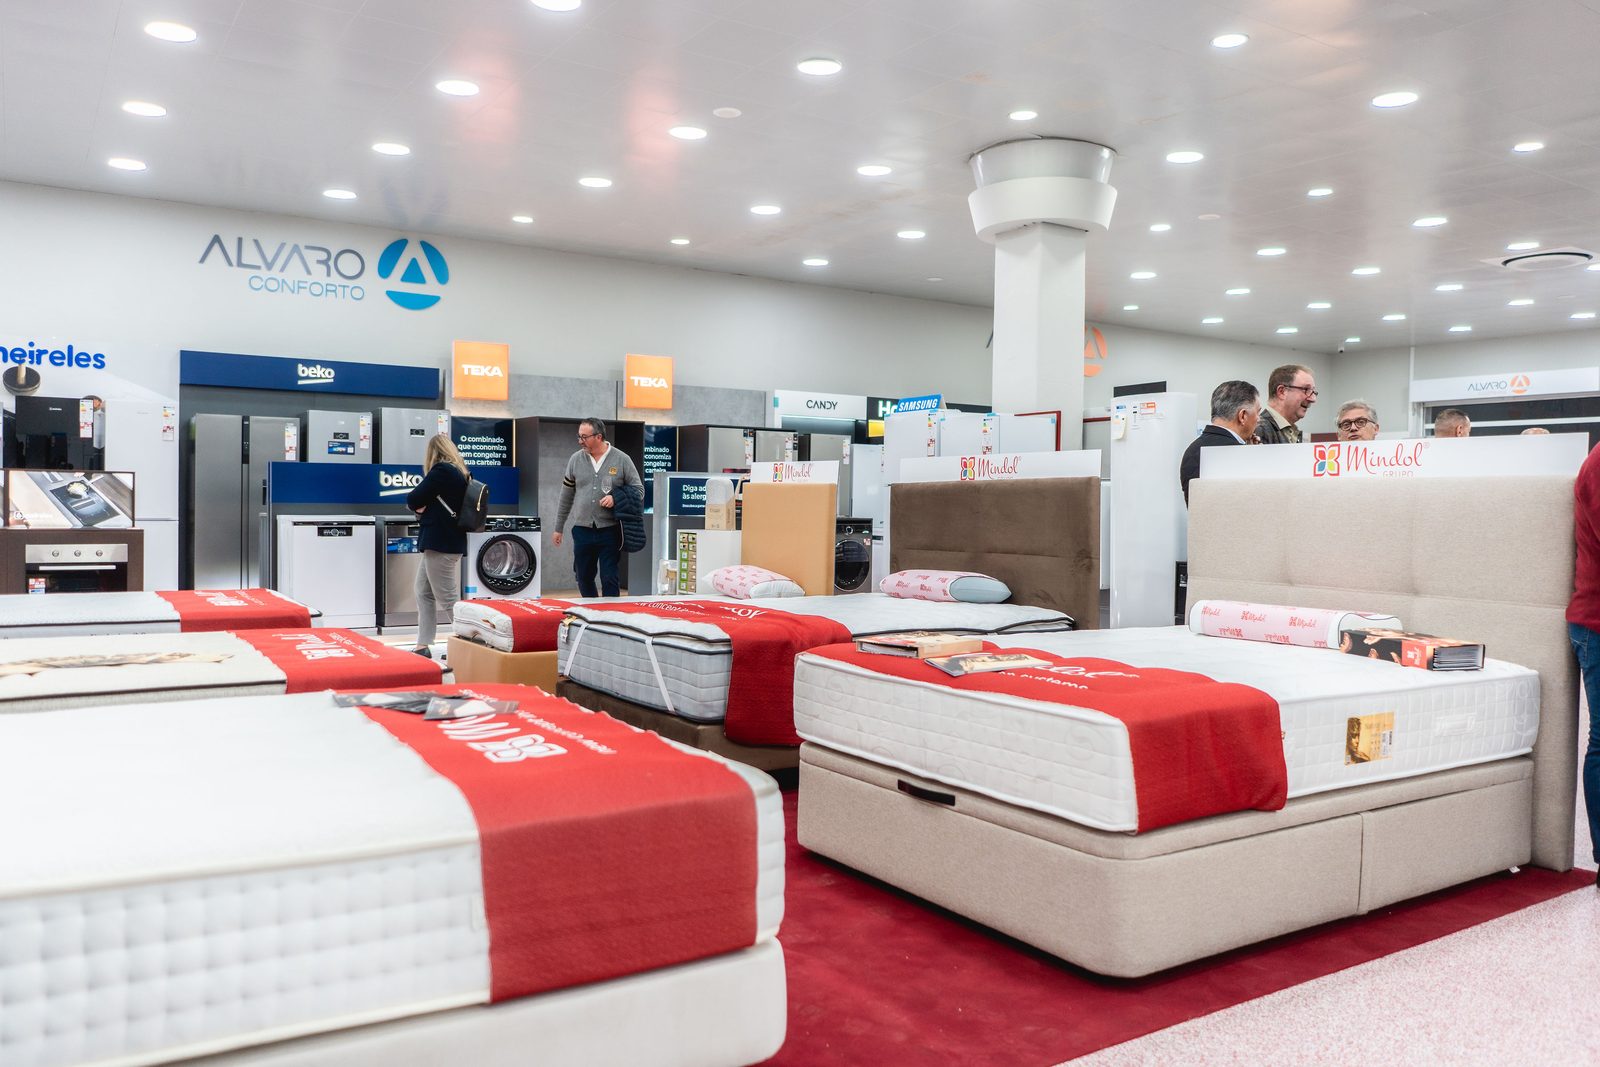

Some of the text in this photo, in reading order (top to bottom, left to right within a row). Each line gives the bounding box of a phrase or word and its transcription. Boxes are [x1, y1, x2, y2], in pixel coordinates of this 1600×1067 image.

[198, 234, 365, 281] ALVARO
[249, 275, 365, 301] CONFORTO
[297, 364, 335, 379] beko
[461, 364, 504, 378] TEKA
[630, 376, 668, 388] TEKA
[1467, 380, 1508, 392] ALVARO
[806, 399, 838, 410] CANDY
[898, 398, 939, 412] SAMSUNG
[457, 443, 471, 451] que
[473, 451, 502, 459] congelar
[1346, 441, 1423, 475] Mindol
[978, 455, 1019, 480] Mindol
[379, 471, 423, 487] beko
[682, 484, 698, 492] Diga
